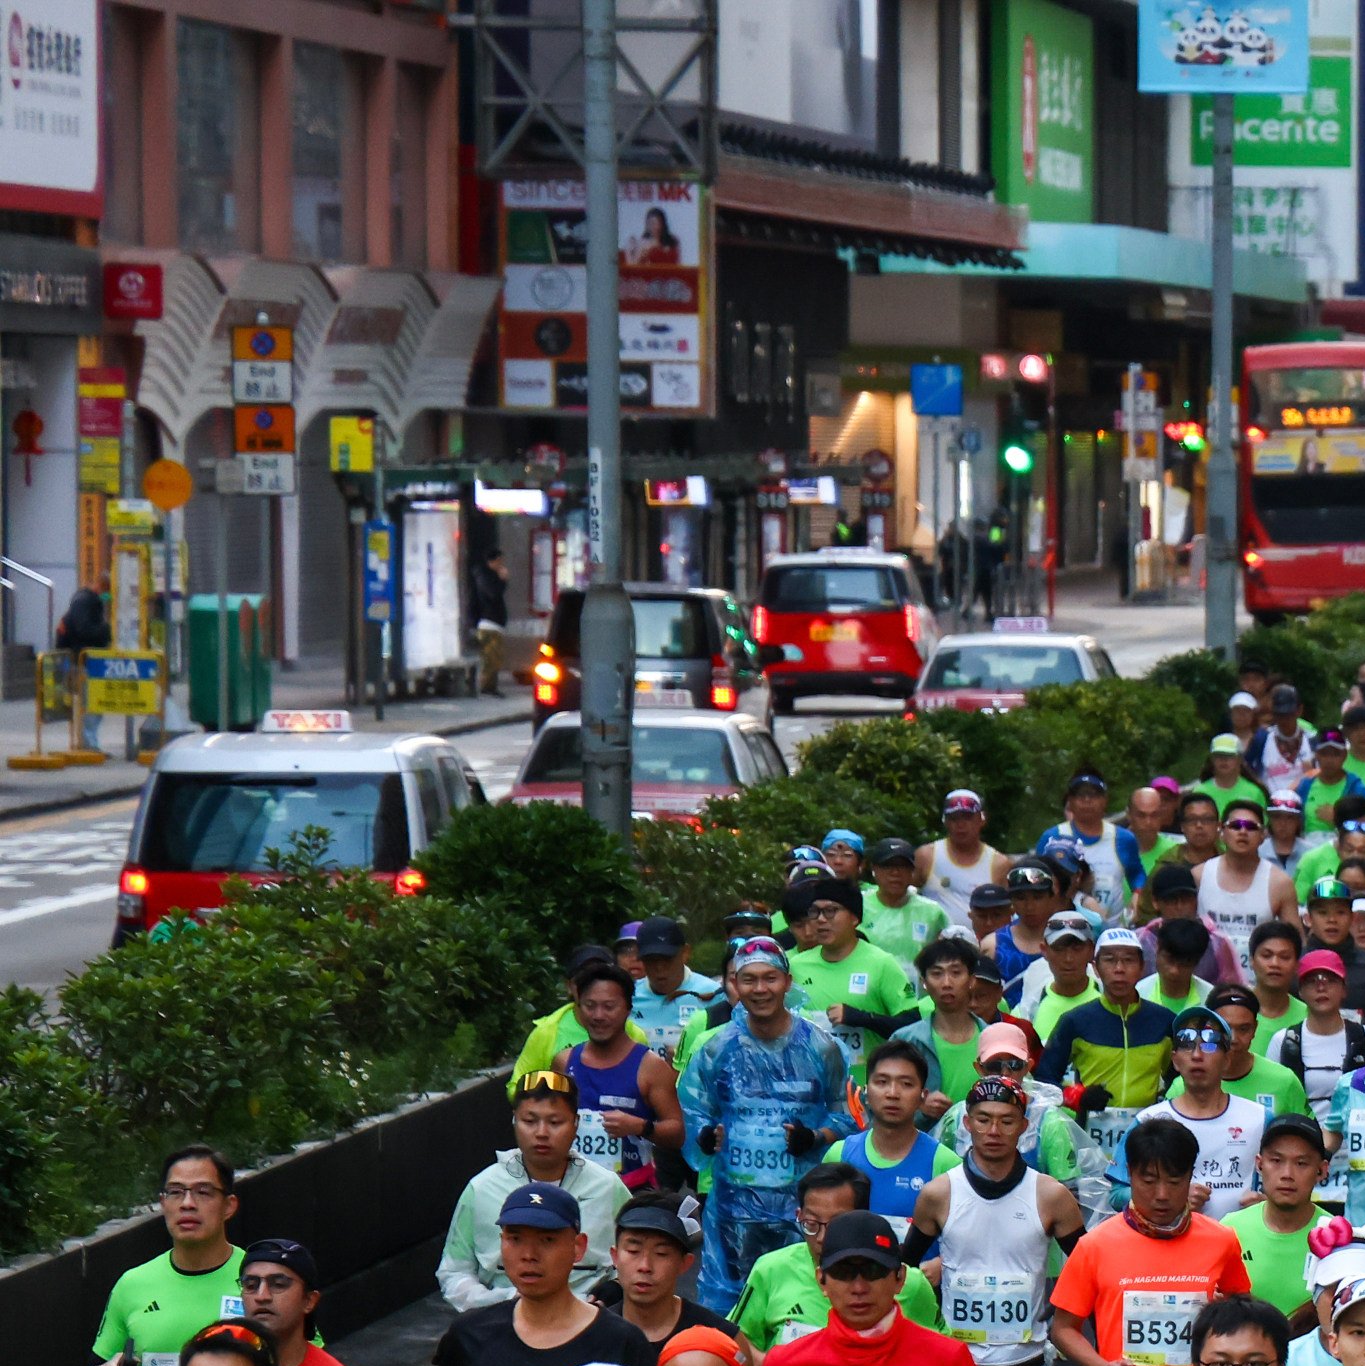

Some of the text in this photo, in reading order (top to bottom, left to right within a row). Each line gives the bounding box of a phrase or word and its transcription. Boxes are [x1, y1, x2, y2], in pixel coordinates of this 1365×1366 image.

[1200, 111, 1339, 142] Picerite
[105, 662, 139, 677] 20A
[272, 713, 342, 729] TAXI
[729, 1145, 792, 1171] B3830
[1204, 1180, 1243, 1190] Runner
[1169, 1275, 1210, 1285] MARATHON
[953, 1298, 1029, 1323] B5130
